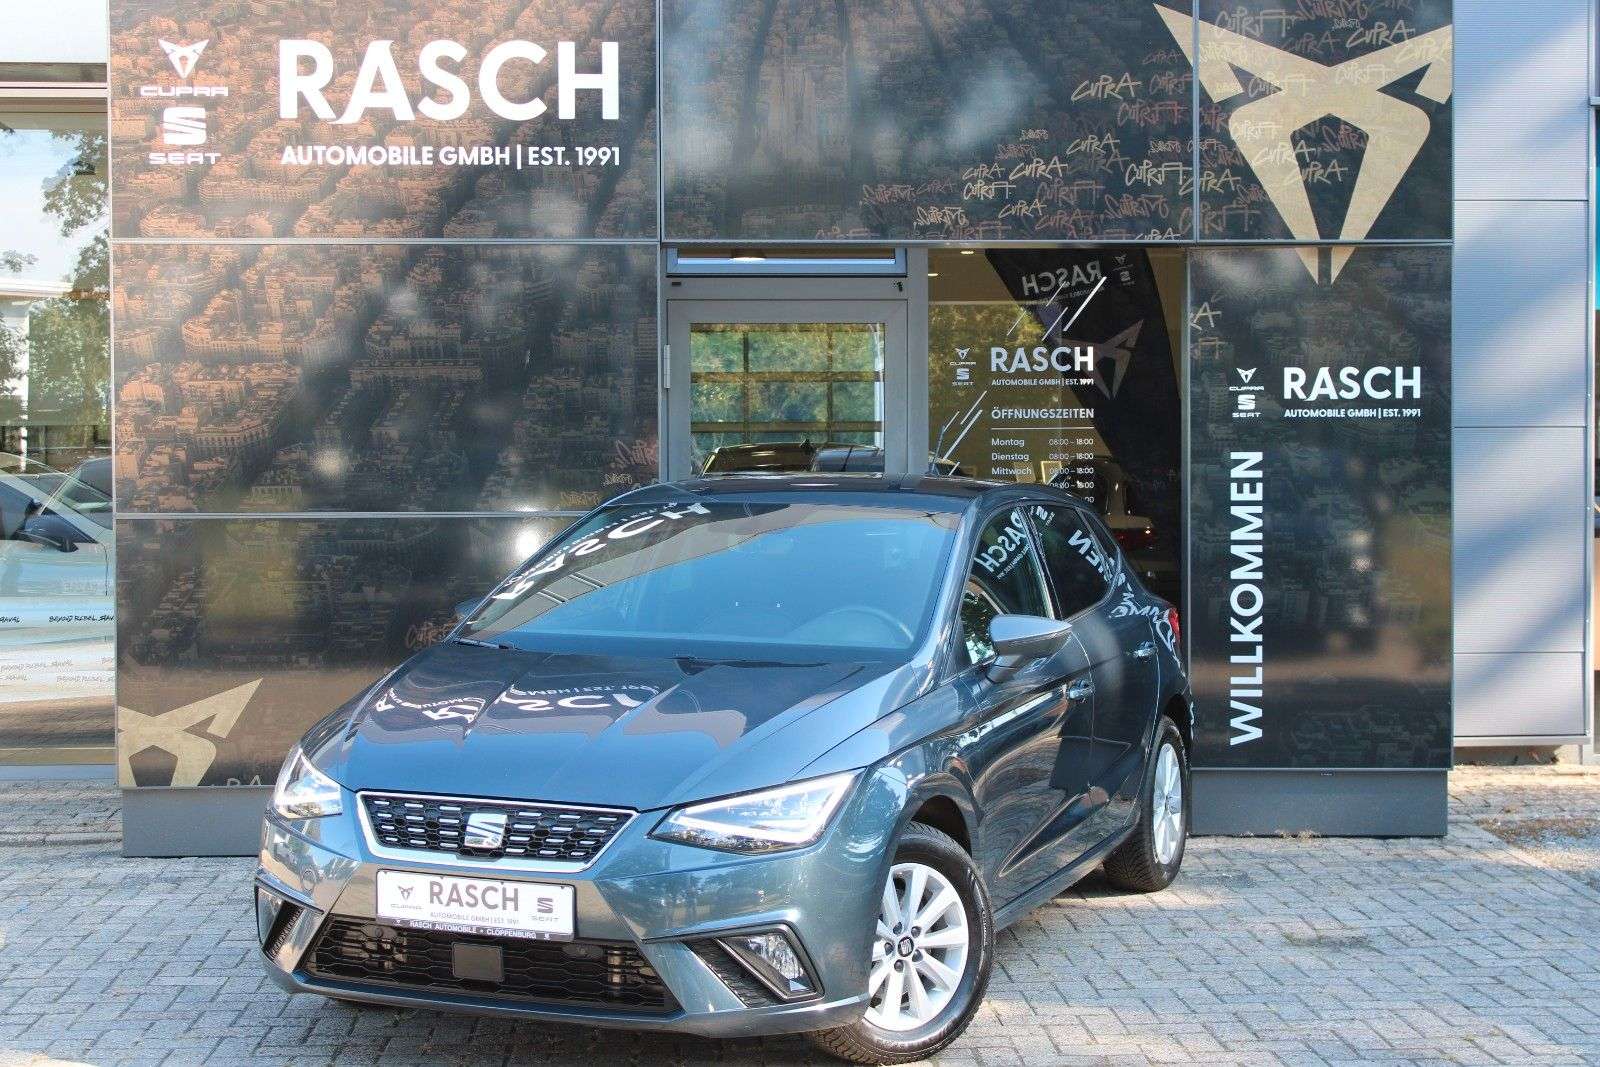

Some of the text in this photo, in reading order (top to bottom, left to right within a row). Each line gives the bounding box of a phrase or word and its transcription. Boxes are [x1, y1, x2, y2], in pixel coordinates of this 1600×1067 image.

[140, 85, 229, 97] CUPRA
[279, 40, 619, 125] RASCH
[1071, 72, 1141, 103] CUPRA
[1066, 133, 1121, 155] CUPRA
[149, 152, 221, 165] SEAT
[281, 145, 434, 167] AUTOMOBILE
[439, 145, 510, 167] GMBH
[528, 146, 571, 166] EST.
[576, 146, 620, 166] 1991
[1009, 156, 1068, 180] CUPRA
[991, 346, 1094, 374] RASCH
[992, 378, 1038, 386] AUTOMOBILE
[1039, 378, 1061, 386] GMBH
[1284, 366, 1421, 401] RASCH
[992, 407, 1094, 419] ÖFFNUNGSZEITEN
[1284, 408, 1346, 418] AUTOMOBILE
[1347, 408, 1377, 418] GMBH
[1383, 408, 1401, 418] EST.
[1402, 408, 1421, 418] 1991
[992, 438, 1025, 447] Montag
[992, 453, 1030, 461] Dienstag
[992, 467, 1032, 475] Mittwoch
[1230, 451, 1263, 746] WILLKOMMEN
[430, 880, 519, 912] RASCH
[409, 920, 537, 940] RASCH AUTOMOBILE CLOPPENBURG
